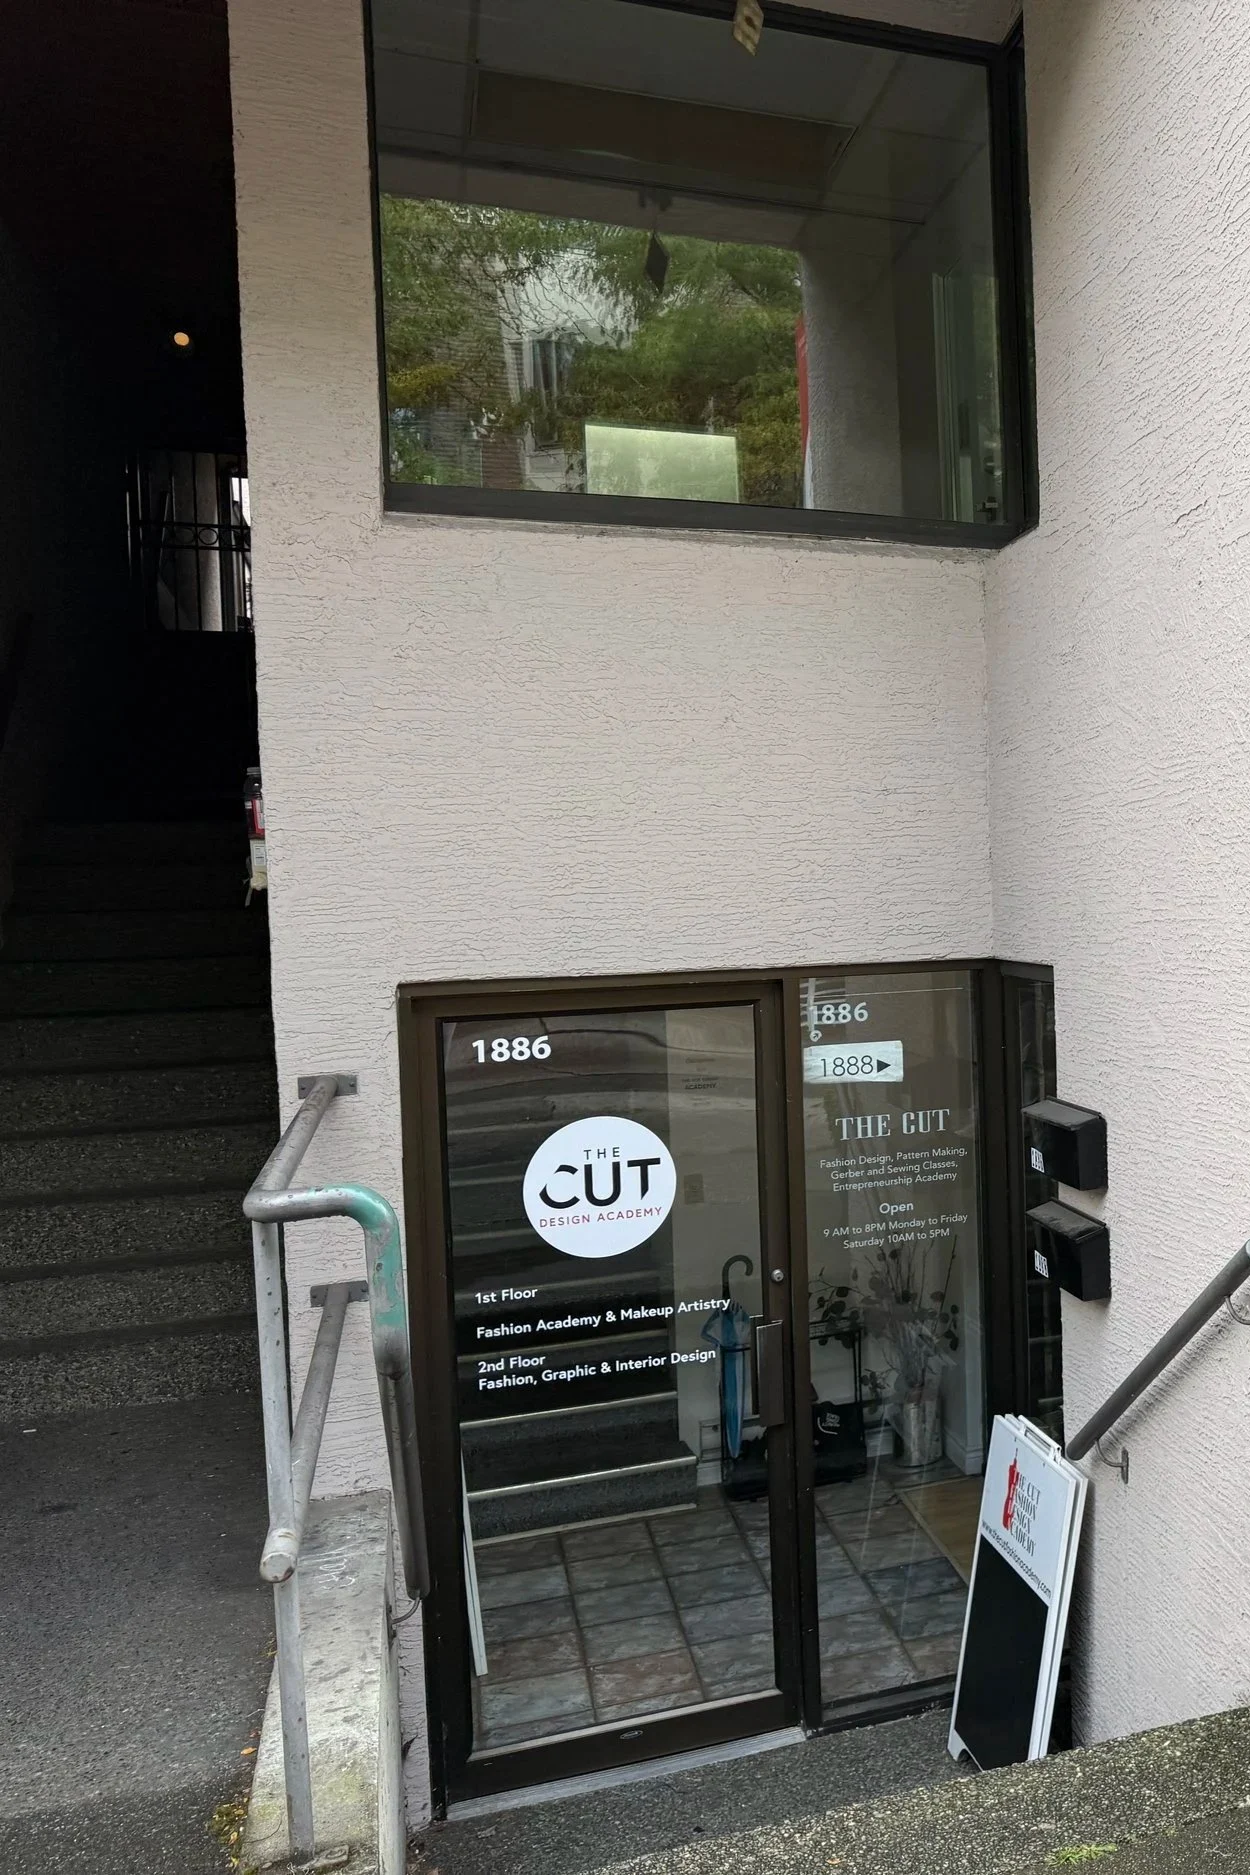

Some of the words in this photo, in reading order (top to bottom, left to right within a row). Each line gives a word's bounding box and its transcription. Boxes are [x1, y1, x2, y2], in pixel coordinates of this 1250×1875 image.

[472, 1035, 552, 1064] 1886
[821, 1055, 873, 1077] 1888
[835, 1114, 891, 1140] THE
[902, 1109, 950, 1135] CUT
[584, 1147, 620, 1160] THE
[820, 1158, 856, 1169] Fashion
[859, 1154, 894, 1165] Design,
[896, 1151, 929, 1160] Pattern
[932, 1147, 968, 1157] Making,
[831, 1169, 864, 1180] Gerber
[867, 1166, 885, 1176] and
[887, 1163, 920, 1174] Sewing
[923, 1160, 958, 1170] Classes,
[539, 1157, 661, 1209] CUT
[833, 1176, 913, 1192] Entrepreneurship
[915, 1172, 958, 1183] Academy
[540, 1214, 590, 1228] DESIGN
[597, 1207, 662, 1222] ACADEMY
[879, 1202, 914, 1215] Open
[823, 1229, 830, 1237] 9
[832, 1227, 850, 1237] AM
[852, 1225, 862, 1234] to
[865, 1222, 886, 1233] 8PM
[888, 1219, 926, 1231] Monday
[928, 1216, 938, 1225] to
[940, 1213, 968, 1224] Friday
[843, 1237, 884, 1249] Saturday
[888, 1232, 914, 1243] 10AM
[917, 1231, 927, 1240] to
[929, 1228, 950, 1238] 5PM
[474, 1291, 497, 1304] 1st
[501, 1288, 538, 1301] Floor
[477, 1322, 531, 1339] Fashion
[536, 1315, 601, 1332] Academy
[605, 1311, 617, 1323] &
[620, 1305, 674, 1321] Makeup
[677, 1298, 731, 1314] Artistry
[478, 1360, 504, 1374] 2nd
[509, 1355, 546, 1369] Floor
[479, 1374, 537, 1391] Fashion,
[541, 1363, 596, 1383] Graphic
[600, 1362, 612, 1374] &
[616, 1355, 666, 1372] Interior
[671, 1349, 716, 1365] Design
[1026, 1480, 1040, 1505] CUT
